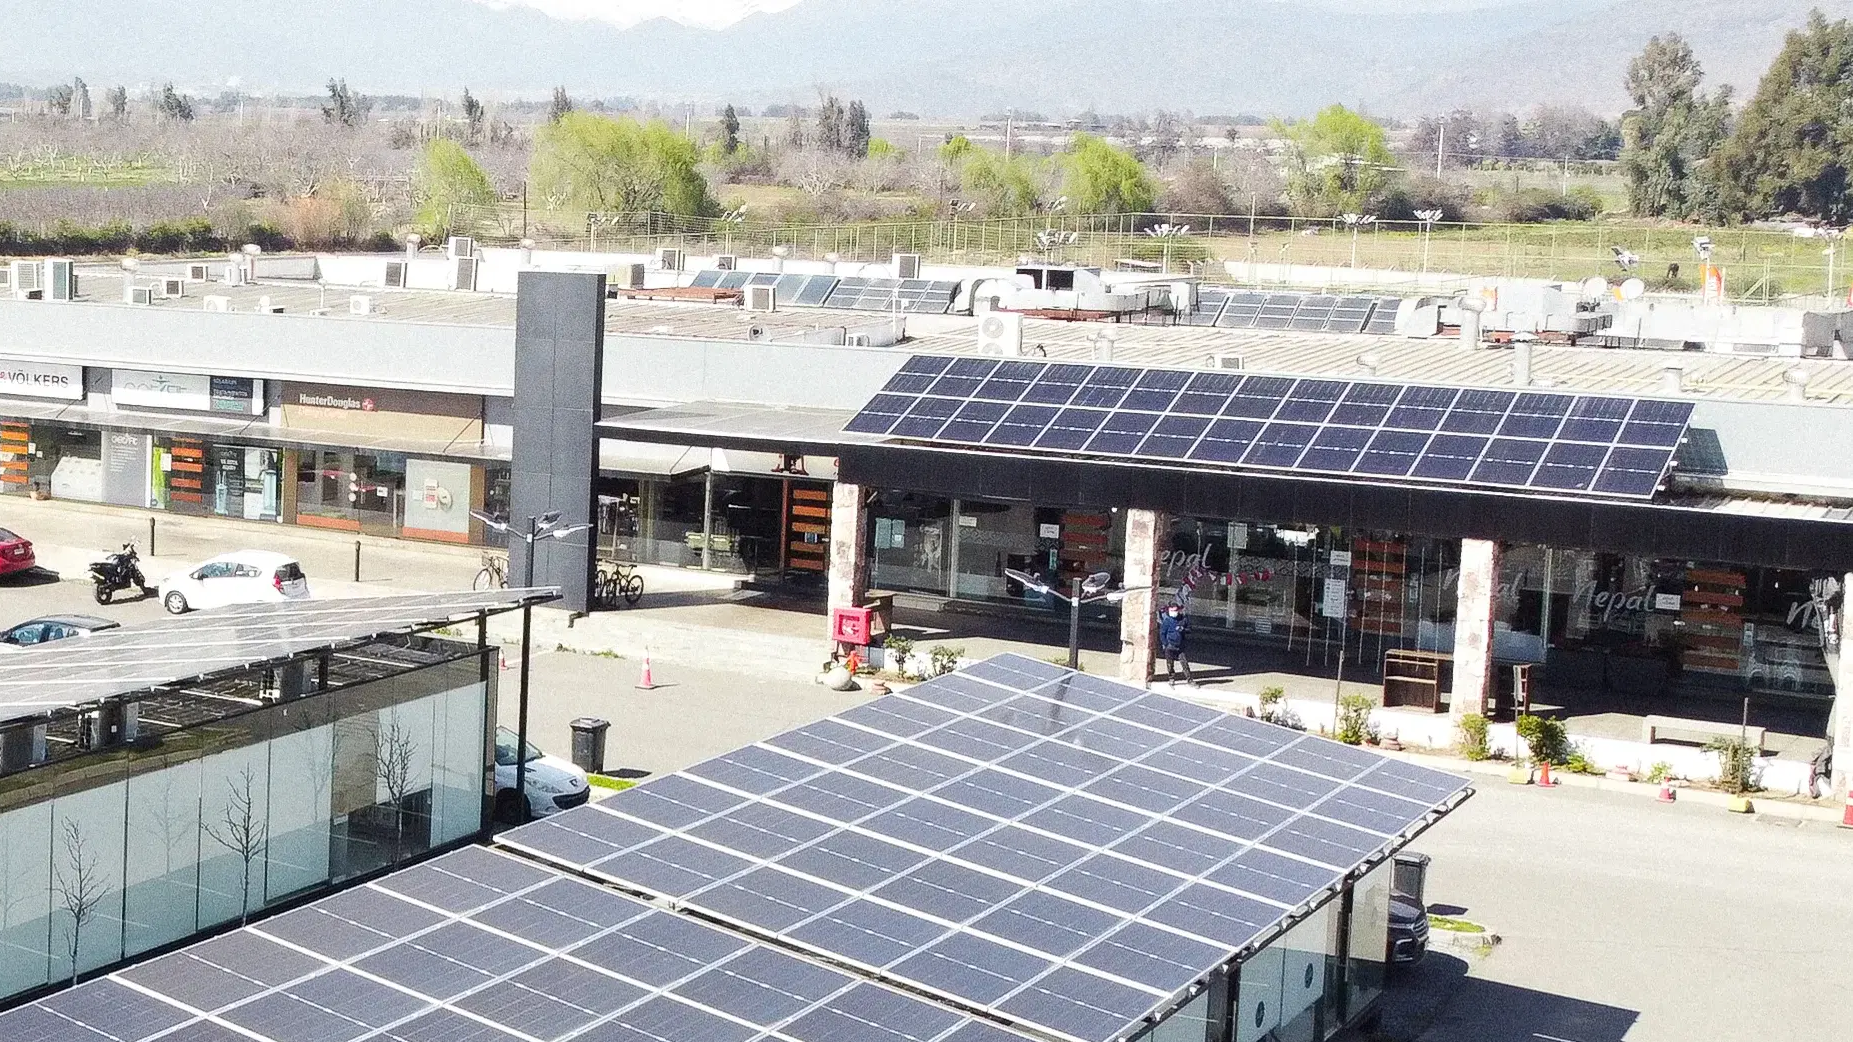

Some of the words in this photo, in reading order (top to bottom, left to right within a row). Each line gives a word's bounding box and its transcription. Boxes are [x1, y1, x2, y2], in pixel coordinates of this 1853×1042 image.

[8, 369, 69, 388] VÖLKERS
[1160, 543, 1213, 578] epal
[1571, 575, 1656, 623] Nepal
